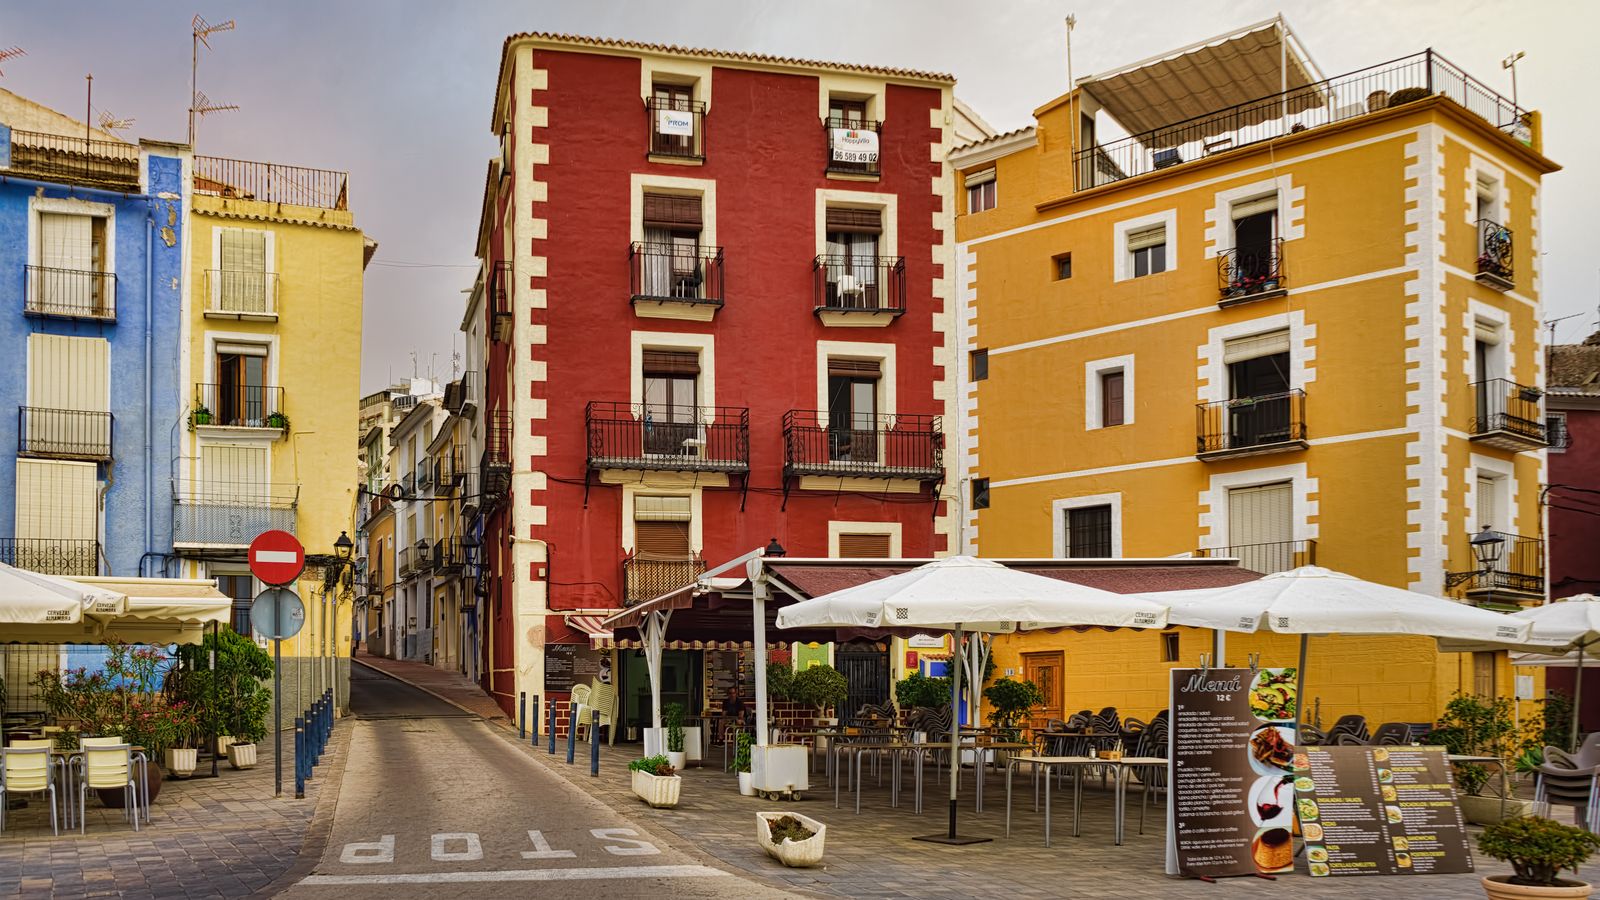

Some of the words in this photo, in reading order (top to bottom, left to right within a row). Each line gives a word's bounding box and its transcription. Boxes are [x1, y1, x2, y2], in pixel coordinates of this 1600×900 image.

[834, 150, 843, 160] 96
[844, 152, 857, 160] 589
[858, 153, 867, 161] 49
[868, 153, 878, 162] 02
[1181, 674, 1242, 692] Menú
[339, 828, 661, 864] STOP
